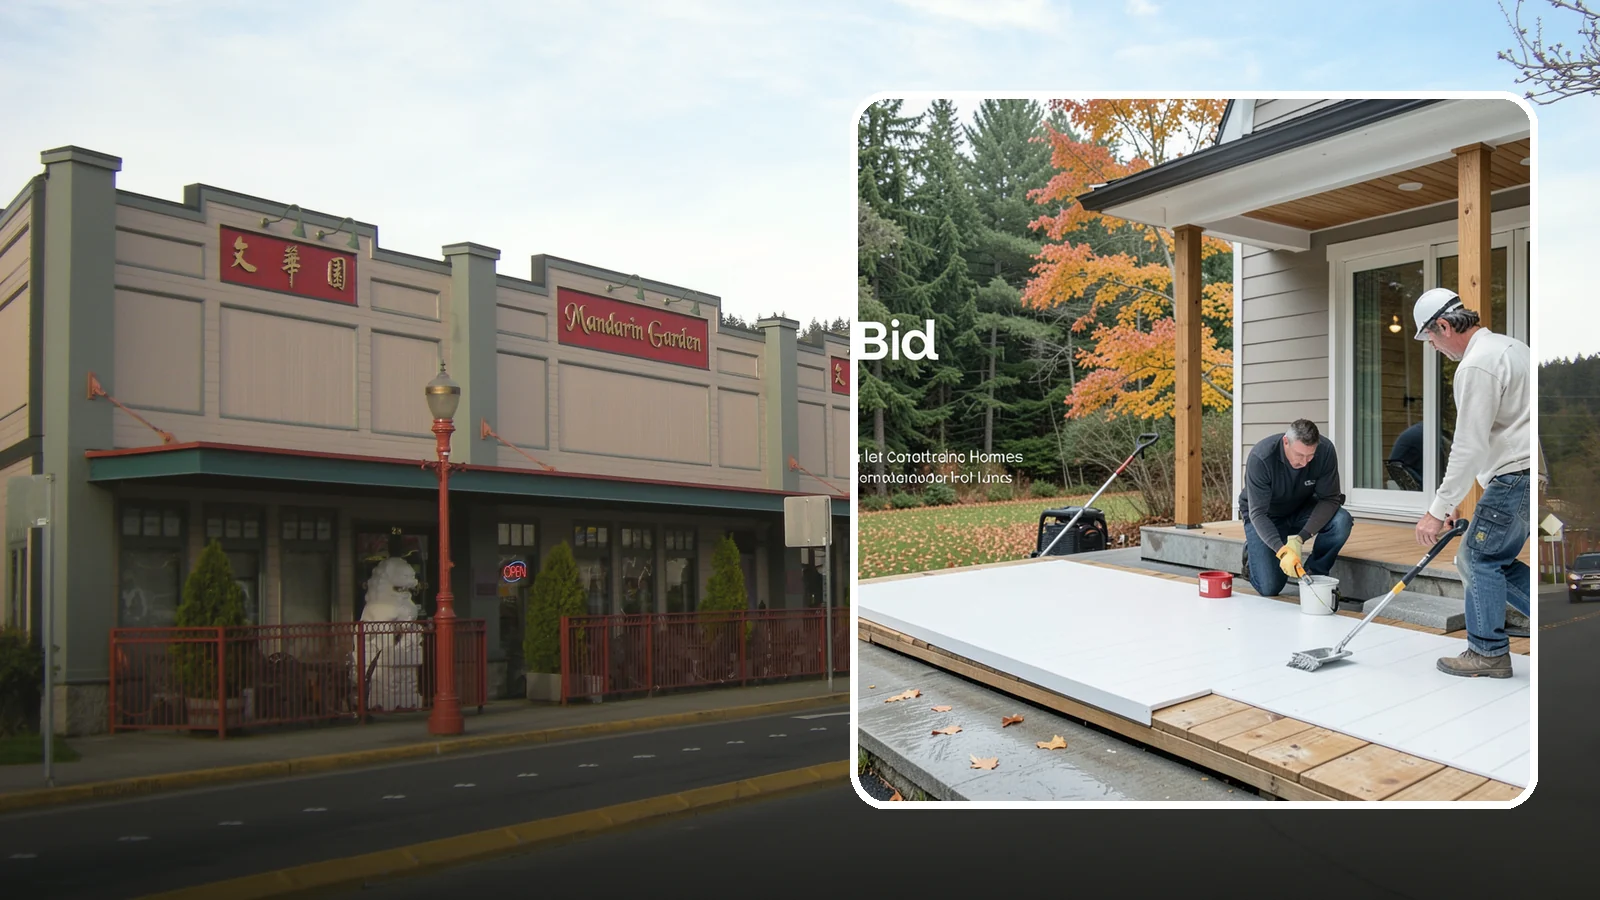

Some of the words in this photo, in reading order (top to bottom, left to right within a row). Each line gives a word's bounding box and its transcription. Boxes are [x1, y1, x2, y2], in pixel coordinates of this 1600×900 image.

[564, 302, 644, 341] Mandarin
[648, 320, 702, 352] Garden
[503, 565, 527, 578] OPEN
